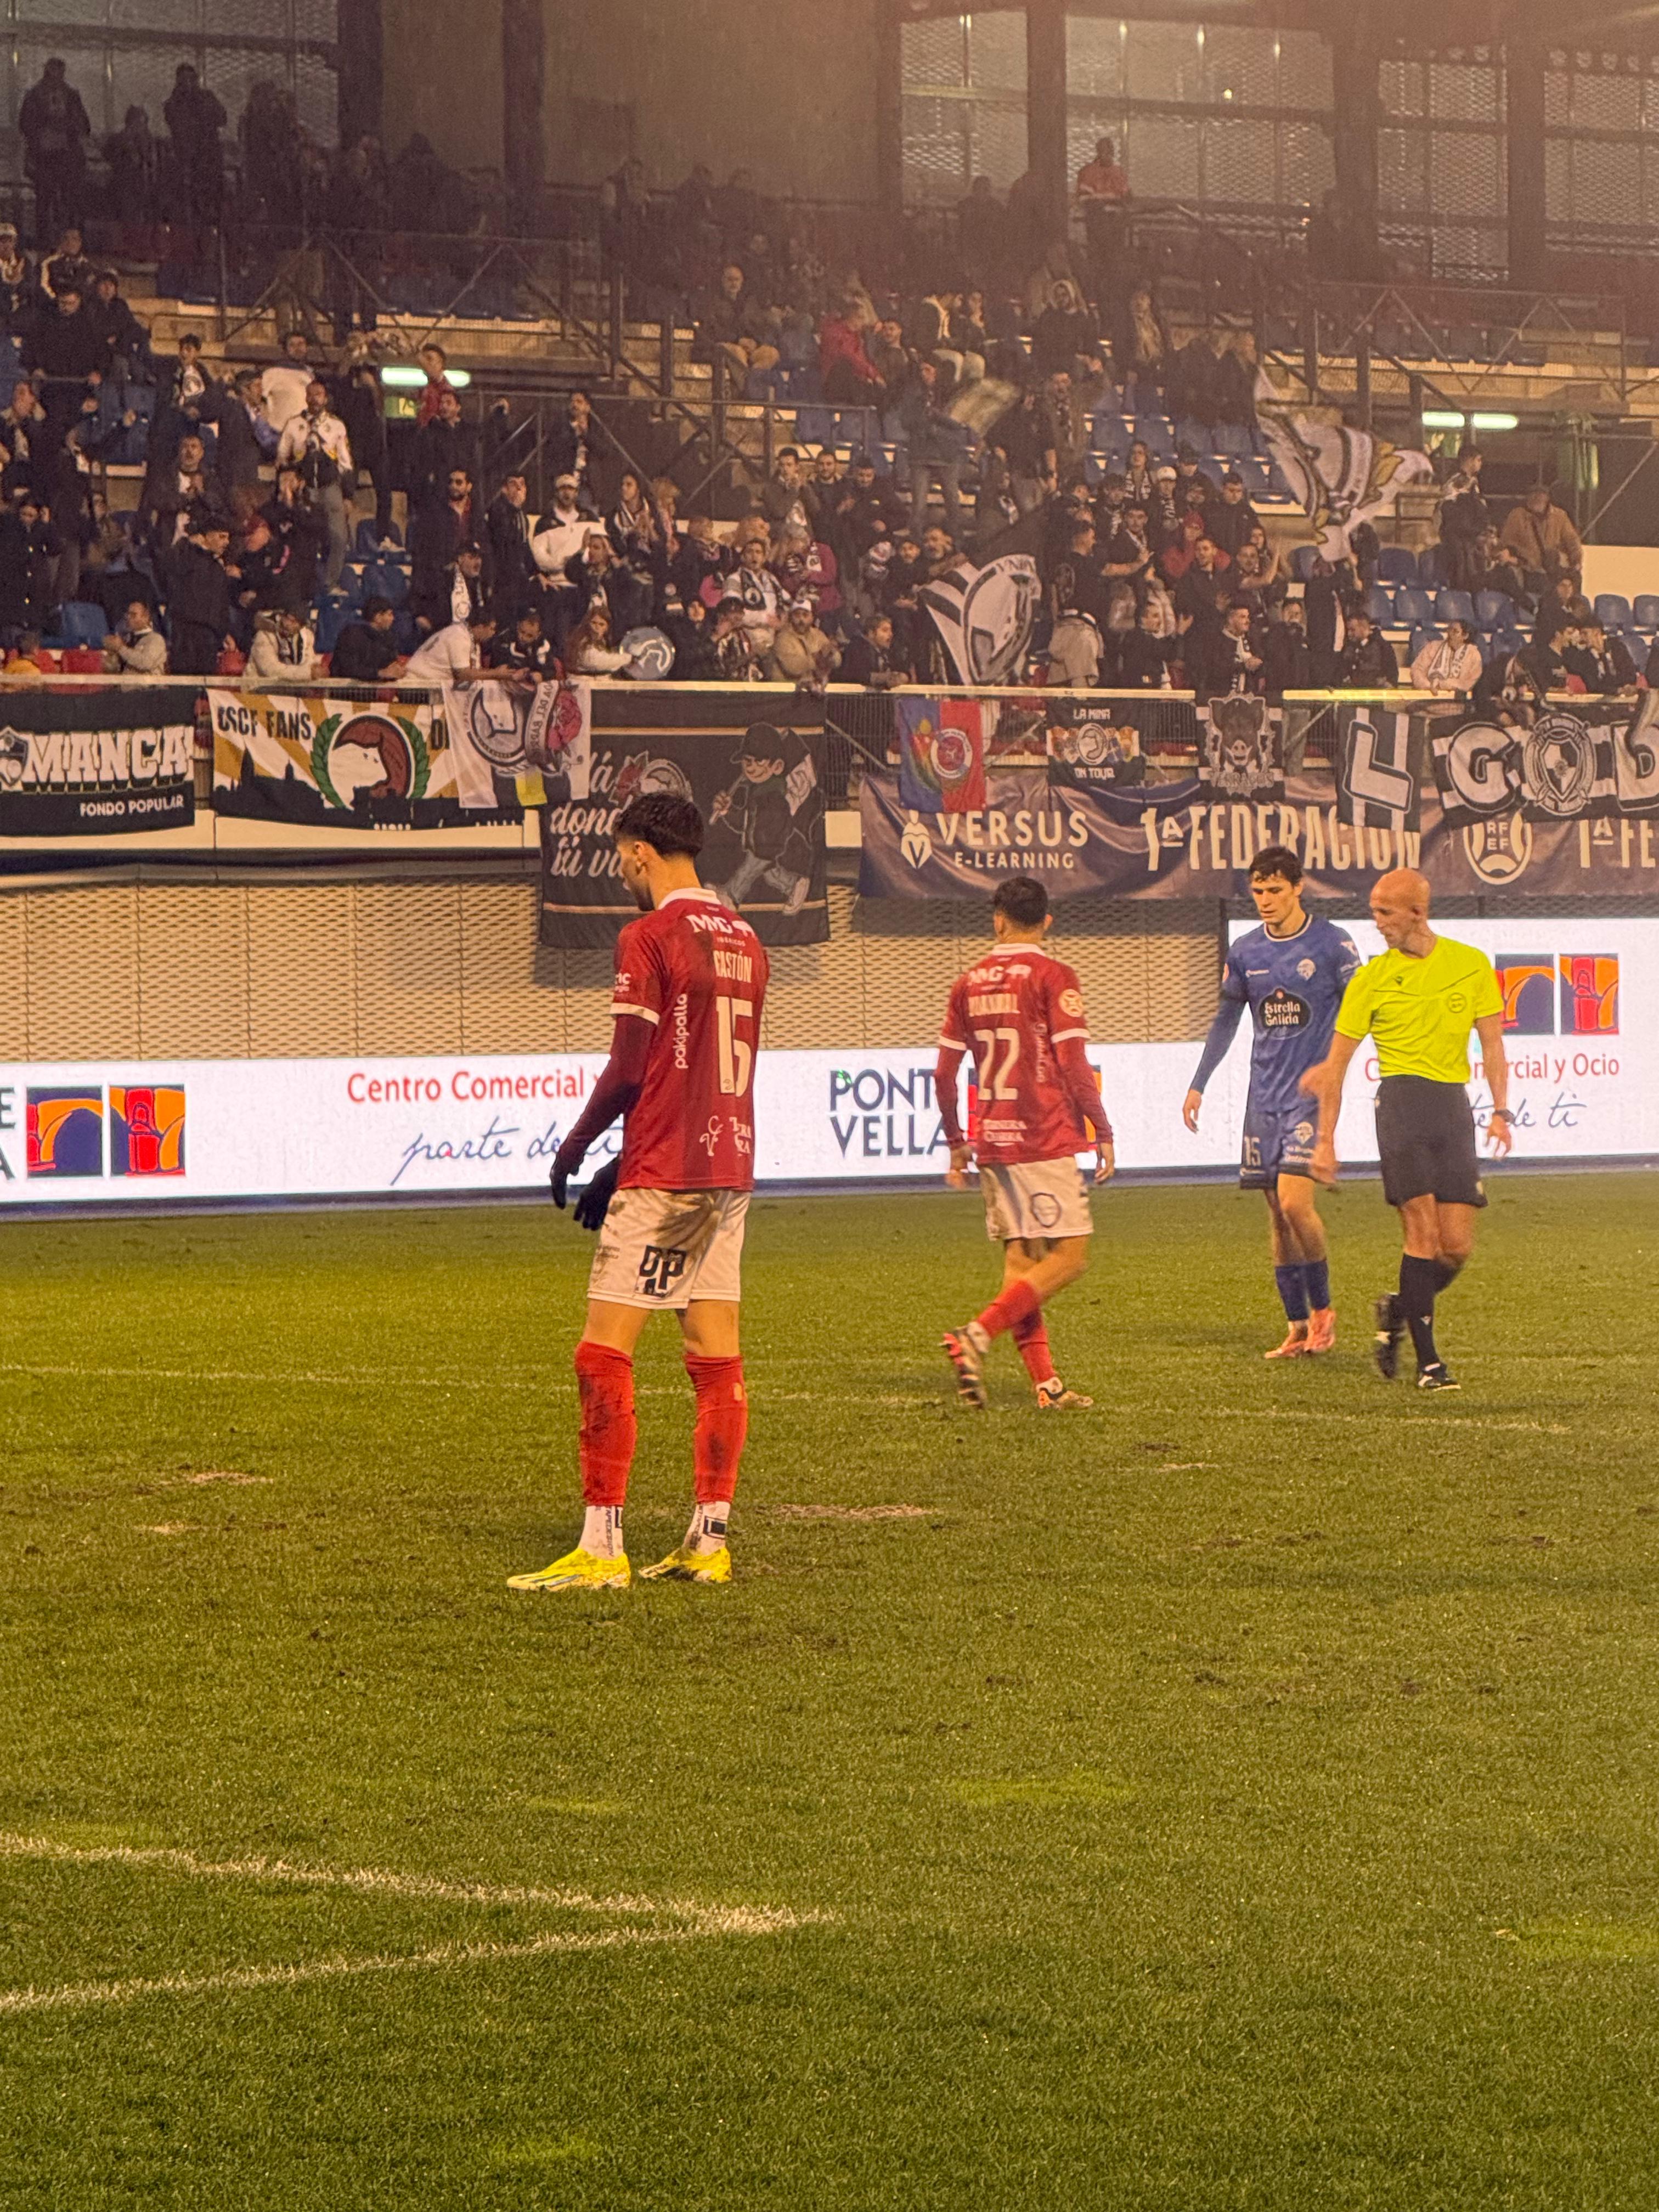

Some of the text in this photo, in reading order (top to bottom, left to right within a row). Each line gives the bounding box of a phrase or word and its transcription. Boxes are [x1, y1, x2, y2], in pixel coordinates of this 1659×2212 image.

[267, 712, 311, 740] FANS
[80, 794, 184, 817] FONDO POPULAR
[935, 810, 1090, 848] VERSUS
[954, 851, 1075, 869] E-LEARNING
[713, 950, 752, 983] GASTÓN
[1265, 1001, 1300, 1014] Estrella
[1265, 1013, 1299, 1026] Galicia
[675, 993, 689, 1069] pakipallo
[716, 996, 753, 1097] 15
[974, 1028, 1020, 1101] 22
[1554, 1059, 1566, 1084] y
[1573, 1053, 1619, 1076] Ocio
[347, 1065, 584, 1102] Centro Comercial
[830, 1068, 936, 1111] PONT
[1548, 1092, 1588, 1128] ti
[390, 1115, 520, 1186] parte
[830, 1114, 950, 1158] VELLA
[1244, 1136, 1262, 1166] 15
